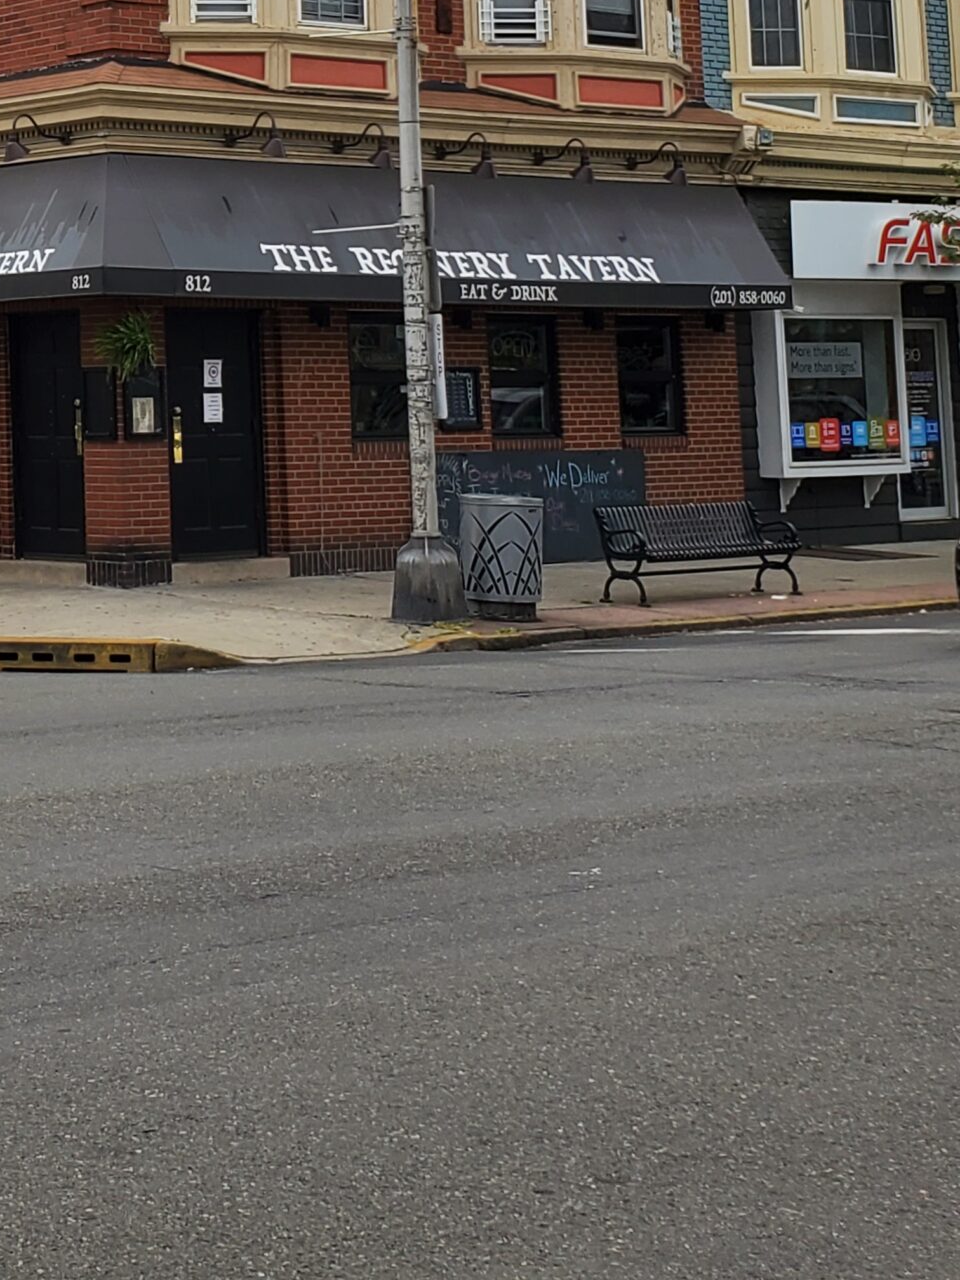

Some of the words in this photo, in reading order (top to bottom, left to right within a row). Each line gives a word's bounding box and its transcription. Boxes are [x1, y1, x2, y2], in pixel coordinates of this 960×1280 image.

[259, 242, 338, 272] THE
[526, 253, 662, 283] TAVERN
[71, 274, 90, 290] 812
[185, 275, 211, 292] 812
[460, 283, 488, 300] EAT
[492, 283, 508, 300] &
[510, 285, 558, 302] DRINK
[710, 285, 736, 307] (201)
[739, 290, 786, 305] 858-0060
[790, 345, 811, 357] More
[813, 345, 832, 357] than
[791, 361, 812, 373] More
[814, 361, 833, 373] than
[544, 459, 568, 488] We
[568, 461, 610, 489] Deliver
